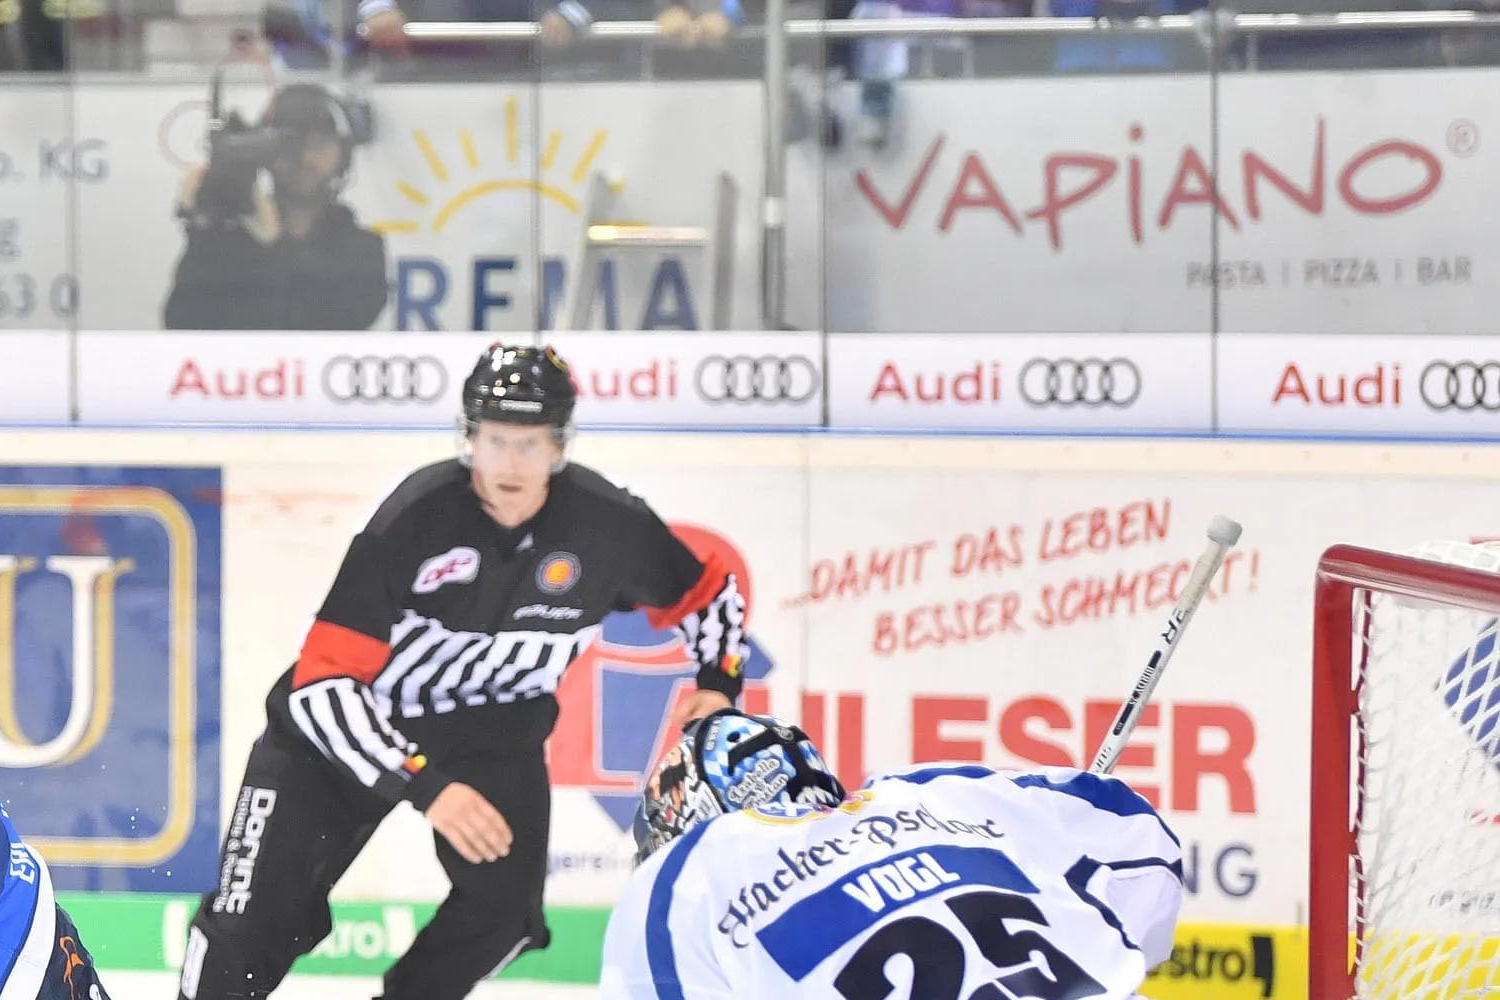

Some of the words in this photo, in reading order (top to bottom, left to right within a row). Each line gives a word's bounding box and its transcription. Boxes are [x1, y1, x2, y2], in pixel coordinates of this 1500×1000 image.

[388, 256, 698, 330] REMA
[171, 358, 304, 400] Audi
[869, 363, 1000, 404] Audi
[1273, 363, 1402, 407] Audi
[1040, 497, 1172, 562] LEBEN
[870, 592, 1026, 656] BESSER
[1036, 548, 1262, 630] SCHMECT!
[842, 852, 961, 913] VOGL
